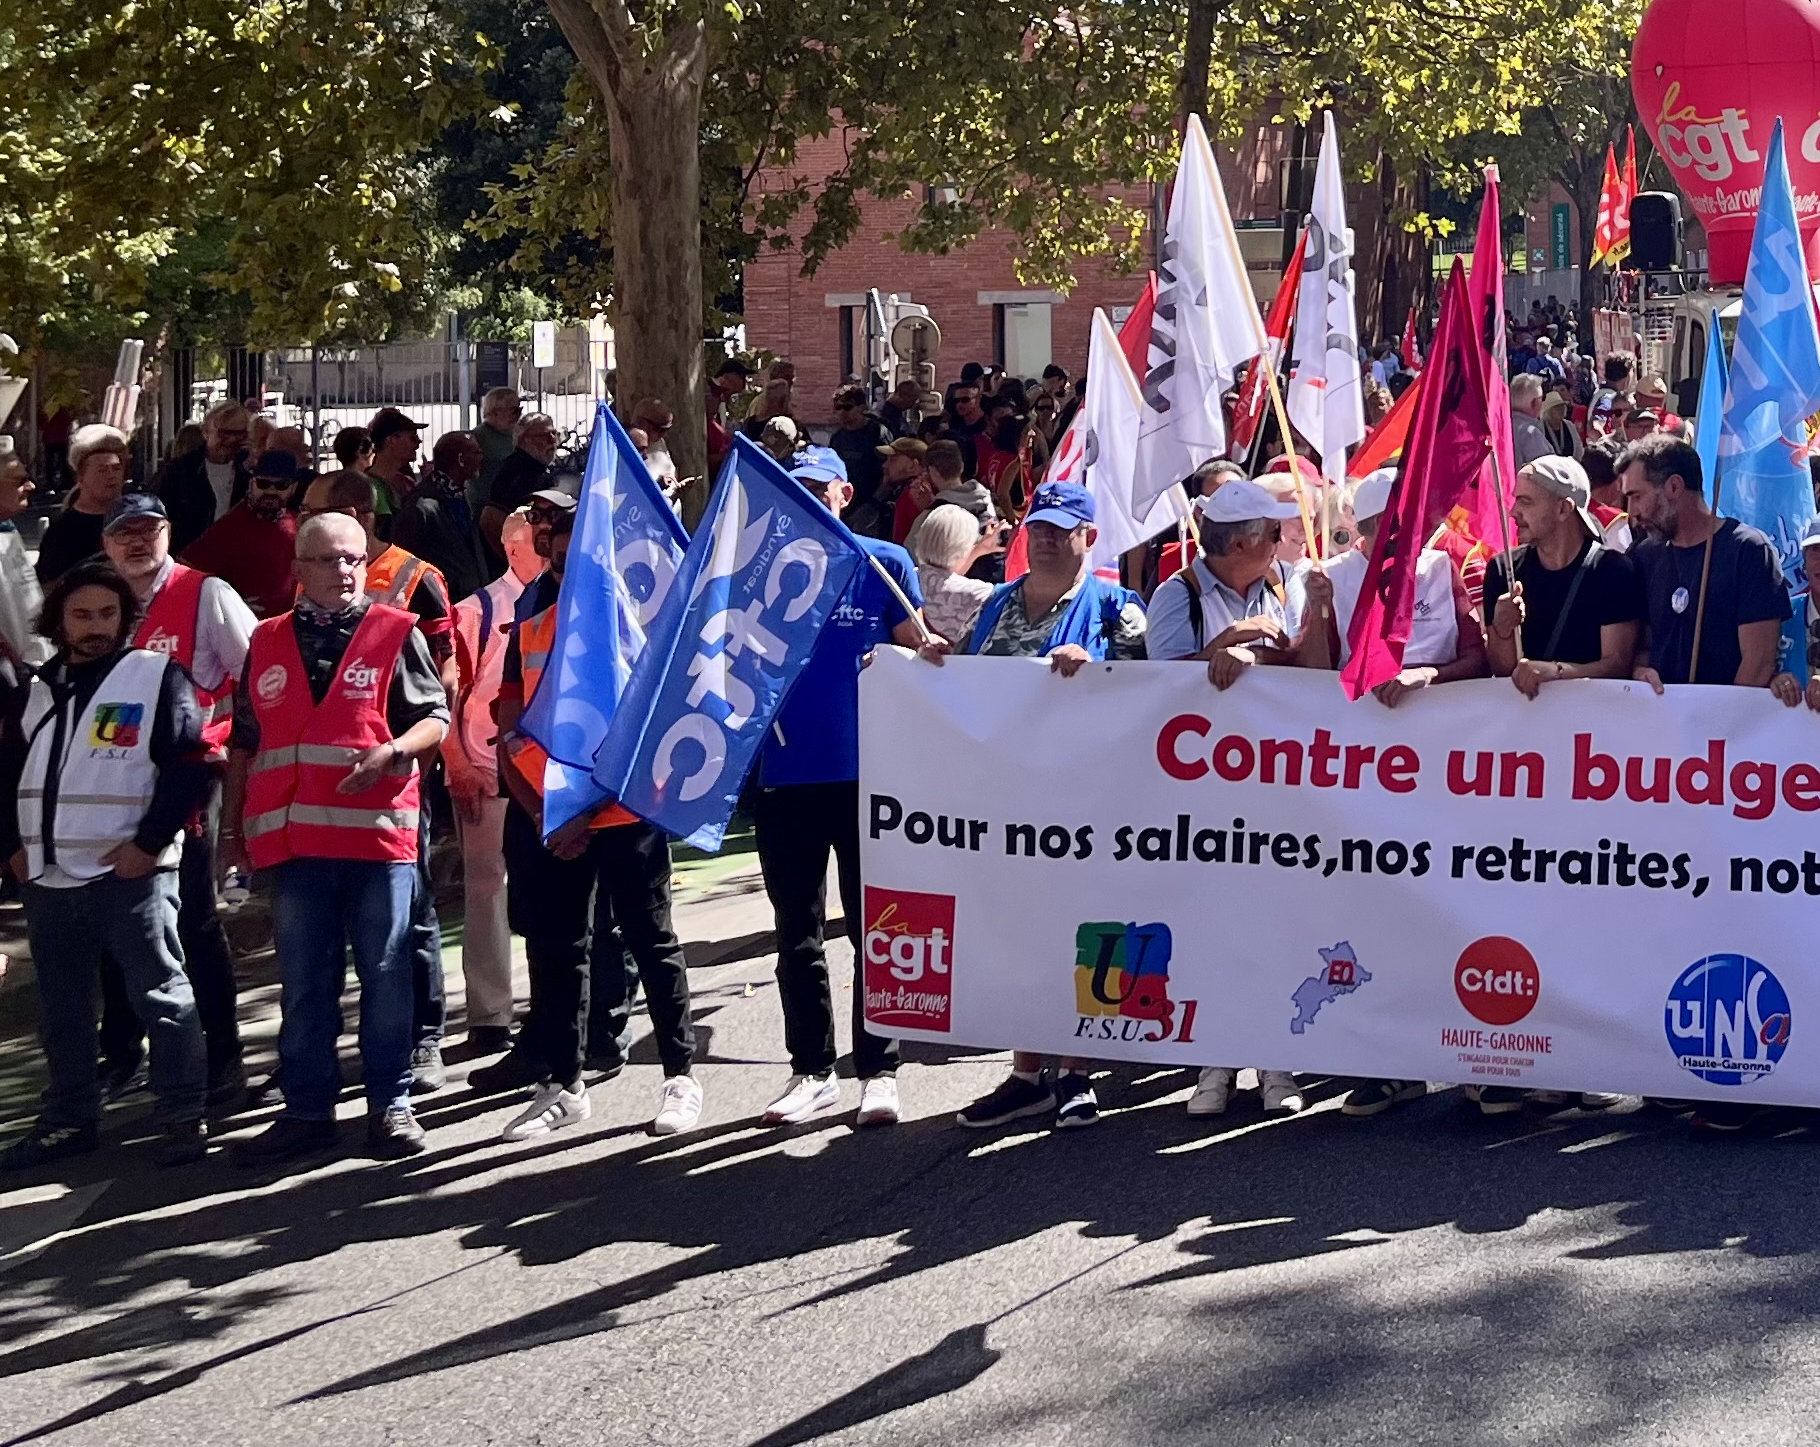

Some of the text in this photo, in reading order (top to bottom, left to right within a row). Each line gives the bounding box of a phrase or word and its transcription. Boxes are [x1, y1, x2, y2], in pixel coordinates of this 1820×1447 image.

[1658, 108, 1760, 182] cgt
[146, 633, 179, 655] cgt
[343, 665, 378, 686] cgt
[1156, 713, 1422, 794] Contre
[1446, 750, 1546, 800] un
[868, 793, 989, 853] Pour
[1004, 821, 1094, 861] nos
[1449, 834, 1710, 899] retraites,
[865, 927, 949, 981] cgt
[1461, 967, 1534, 996] Cfdt:
[1074, 1017, 1145, 1042] F.S.U.
[1441, 1028, 1553, 1054] HAUTE-GARONNE
[1683, 1056, 1772, 1072] Haute-Garonne
